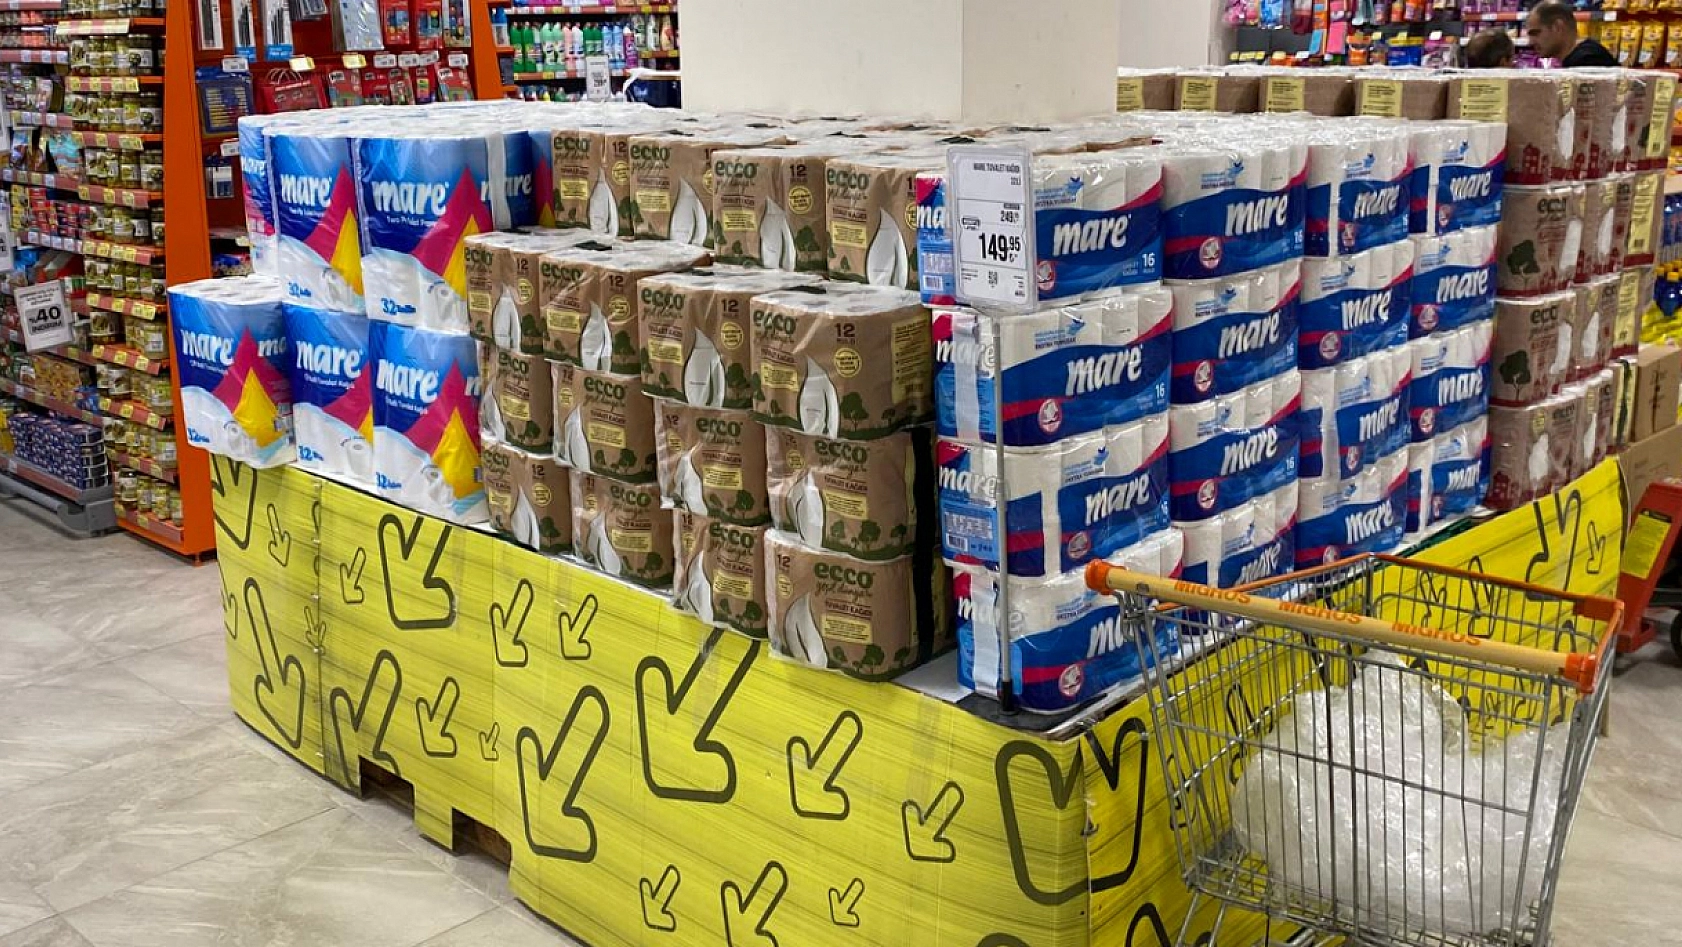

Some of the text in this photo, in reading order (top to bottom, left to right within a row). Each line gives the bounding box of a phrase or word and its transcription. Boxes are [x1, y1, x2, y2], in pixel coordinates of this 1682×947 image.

[612, 141, 628, 153] 12
[630, 144, 672, 160] ecco
[715, 159, 759, 178] ecco
[789, 164, 808, 178] 12
[826, 168, 871, 190] ecco
[280, 172, 332, 207] mare
[1450, 170, 1493, 201] mare
[372, 180, 449, 216] mare
[1354, 185, 1400, 219] mare
[1225, 194, 1288, 236] mare
[1053, 214, 1132, 257] mare
[516, 257, 529, 270] 12
[541, 261, 582, 282] ecco
[1142, 252, 1156, 267] 16
[608, 275, 624, 288] 12
[1436, 268, 1488, 304] mare
[641, 287, 686, 311] ecco
[721, 299, 740, 313] 12
[1341, 289, 1393, 331] mare
[834, 323, 856, 338] 12
[1218, 309, 1281, 359] mare
[181, 329, 235, 366] mare
[296, 339, 363, 379] mare
[376, 359, 440, 403] mare
[1066, 344, 1143, 395] mare
[584, 376, 629, 401] ecco
[1155, 383, 1165, 397] 16
[1359, 398, 1400, 442] mare
[815, 440, 870, 463] ecco
[1220, 425, 1279, 476] mare
[532, 463, 546, 476] 12
[1286, 457, 1296, 470] 16
[939, 465, 997, 498] mare
[1085, 473, 1150, 527] mare
[1344, 498, 1393, 545] mare
[777, 554, 791, 568] 12
[814, 562, 876, 589] ecco
[1174, 580, 1251, 604] MIGROS
[1278, 601, 1363, 624] MIGROS
[1392, 622, 1481, 646] MIGROS
